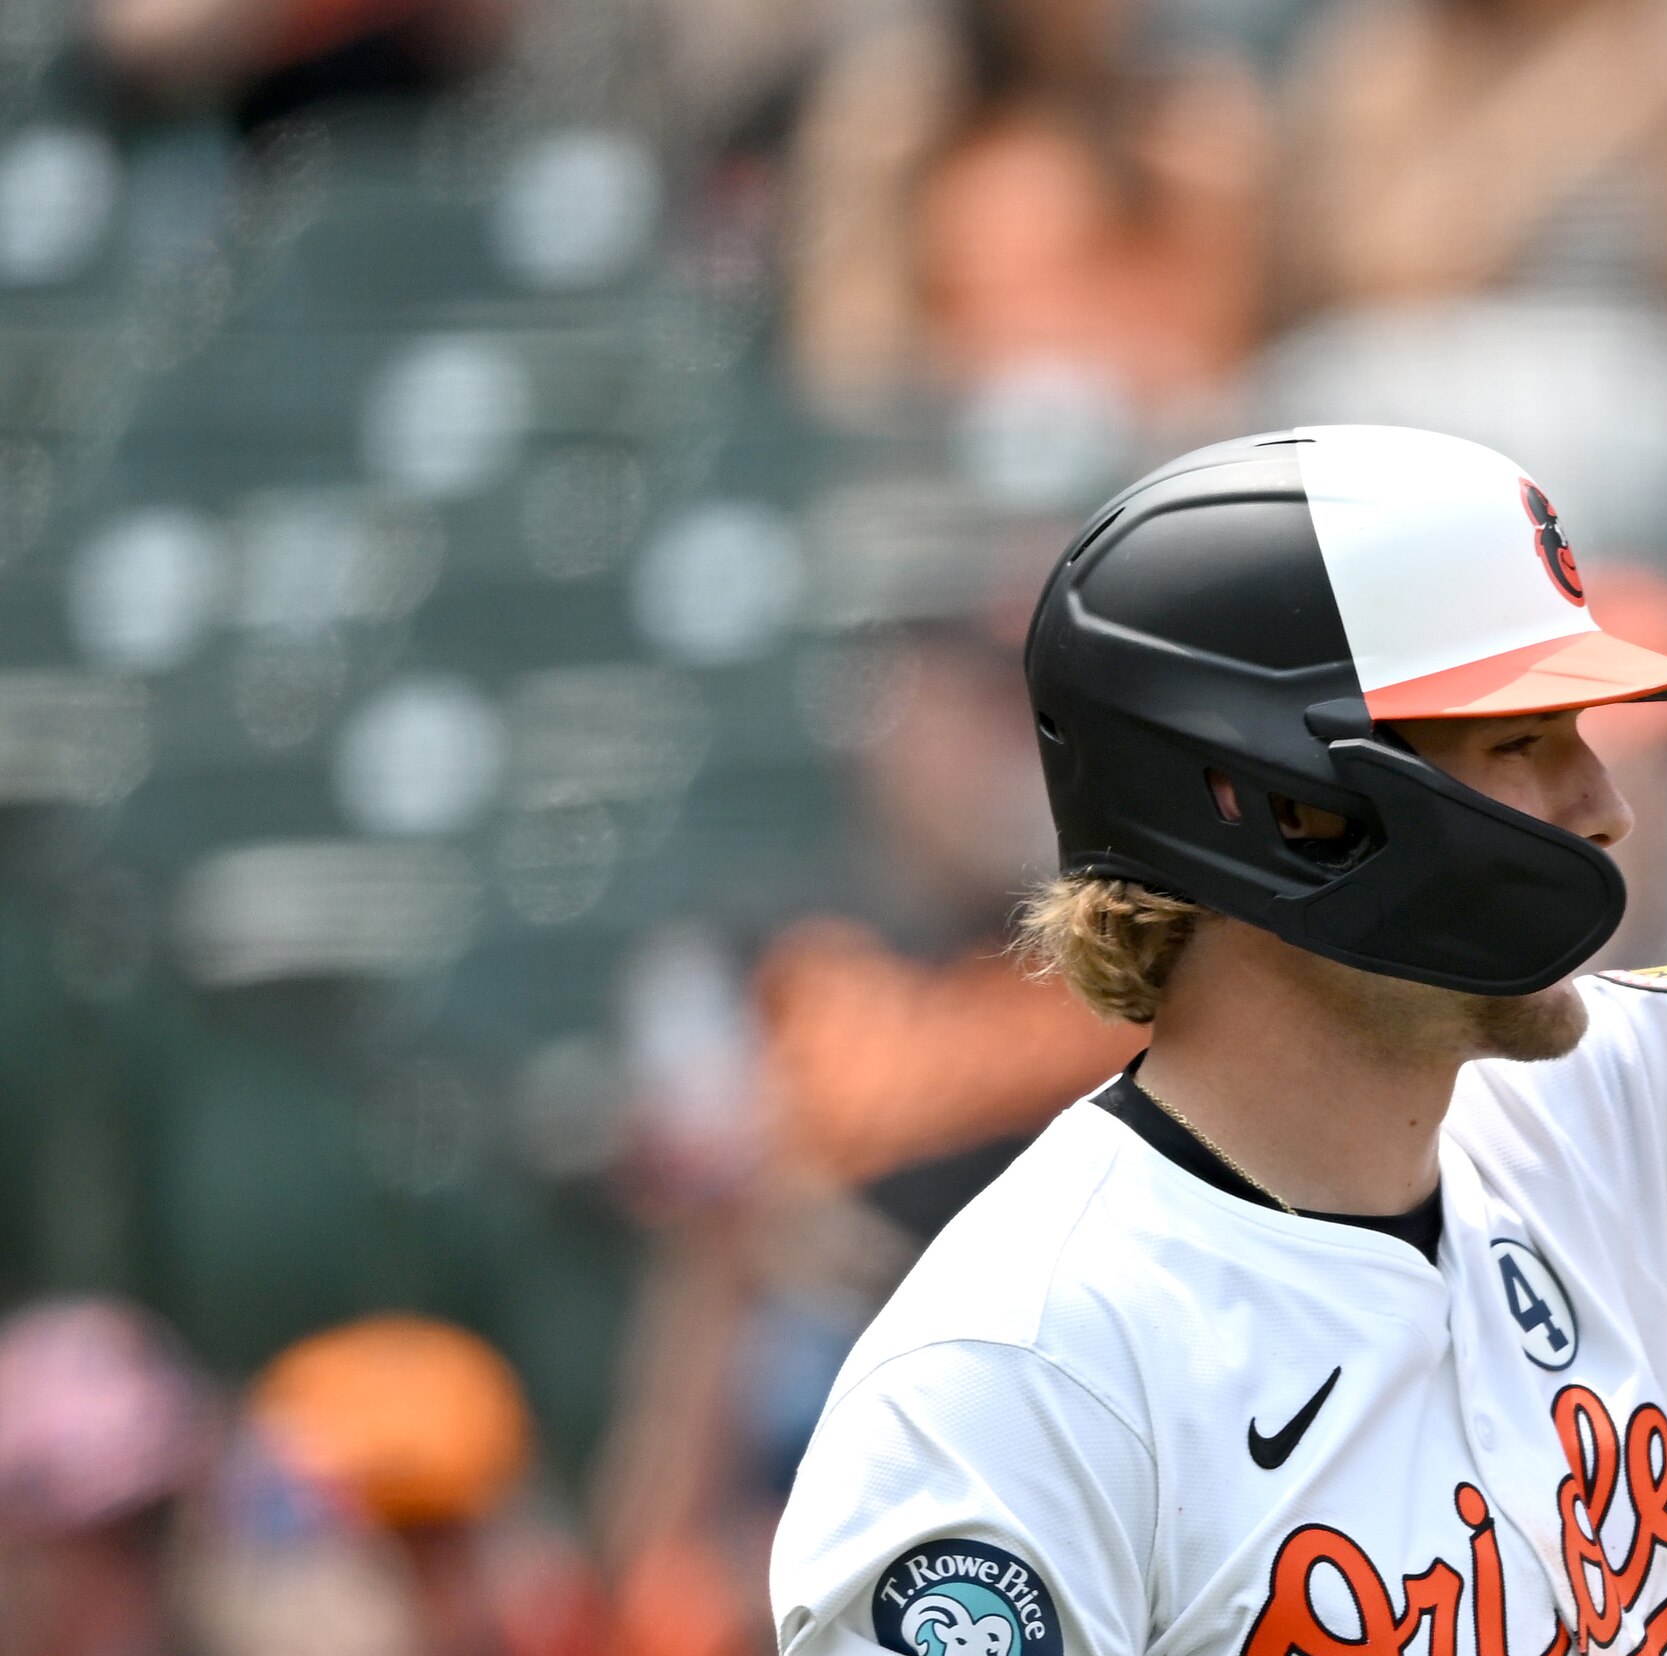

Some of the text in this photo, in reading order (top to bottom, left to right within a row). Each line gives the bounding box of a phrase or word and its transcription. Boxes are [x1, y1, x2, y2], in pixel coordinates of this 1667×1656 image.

[1499, 1253, 1570, 1353] 4
[906, 1554, 1000, 1590] Rowe
[995, 1561, 1046, 1641] Price
